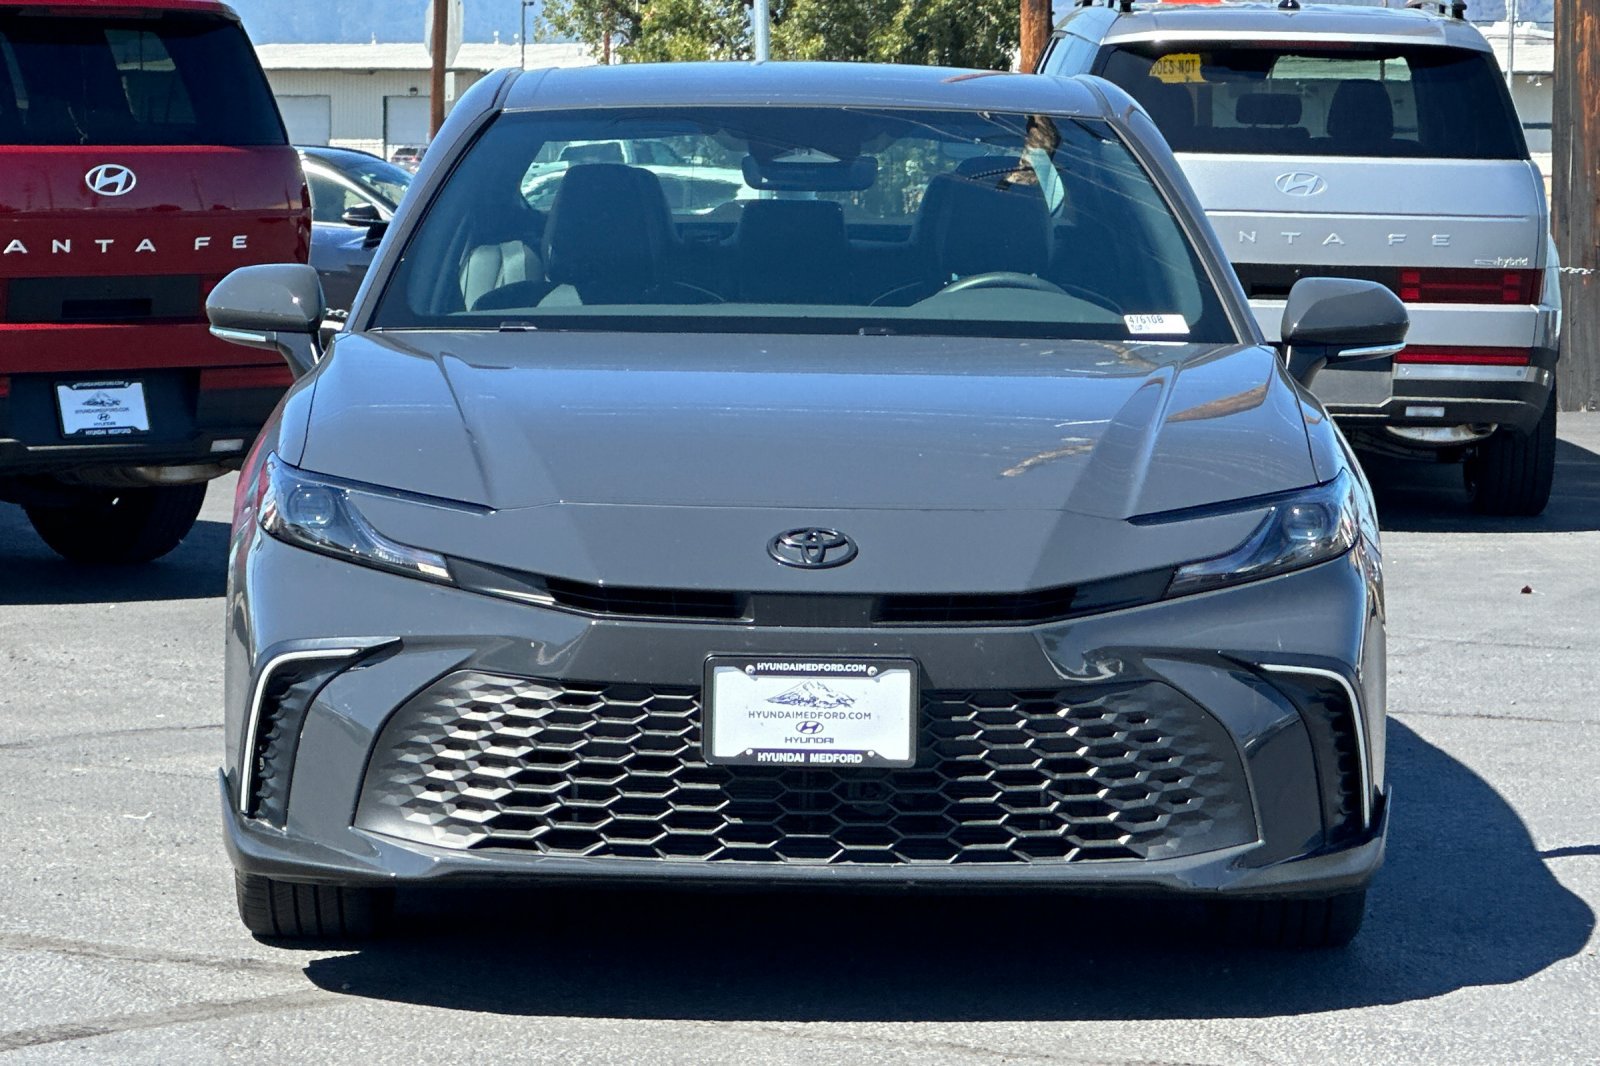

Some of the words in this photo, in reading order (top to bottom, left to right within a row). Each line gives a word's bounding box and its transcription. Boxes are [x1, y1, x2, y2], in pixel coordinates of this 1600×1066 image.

[1178, 59, 1196, 73] NOT
[194, 235, 248, 250] FE
[1388, 233, 1451, 246] FE
[1497, 256, 1528, 268] hybrid
[756, 662, 867, 673] HYUNDAIMEDFORD.COM
[748, 710, 872, 720] HYUNDAIMEDFORD.COM
[757, 753, 805, 763] HYUNDAI
[810, 753, 863, 764] MEDFORD
